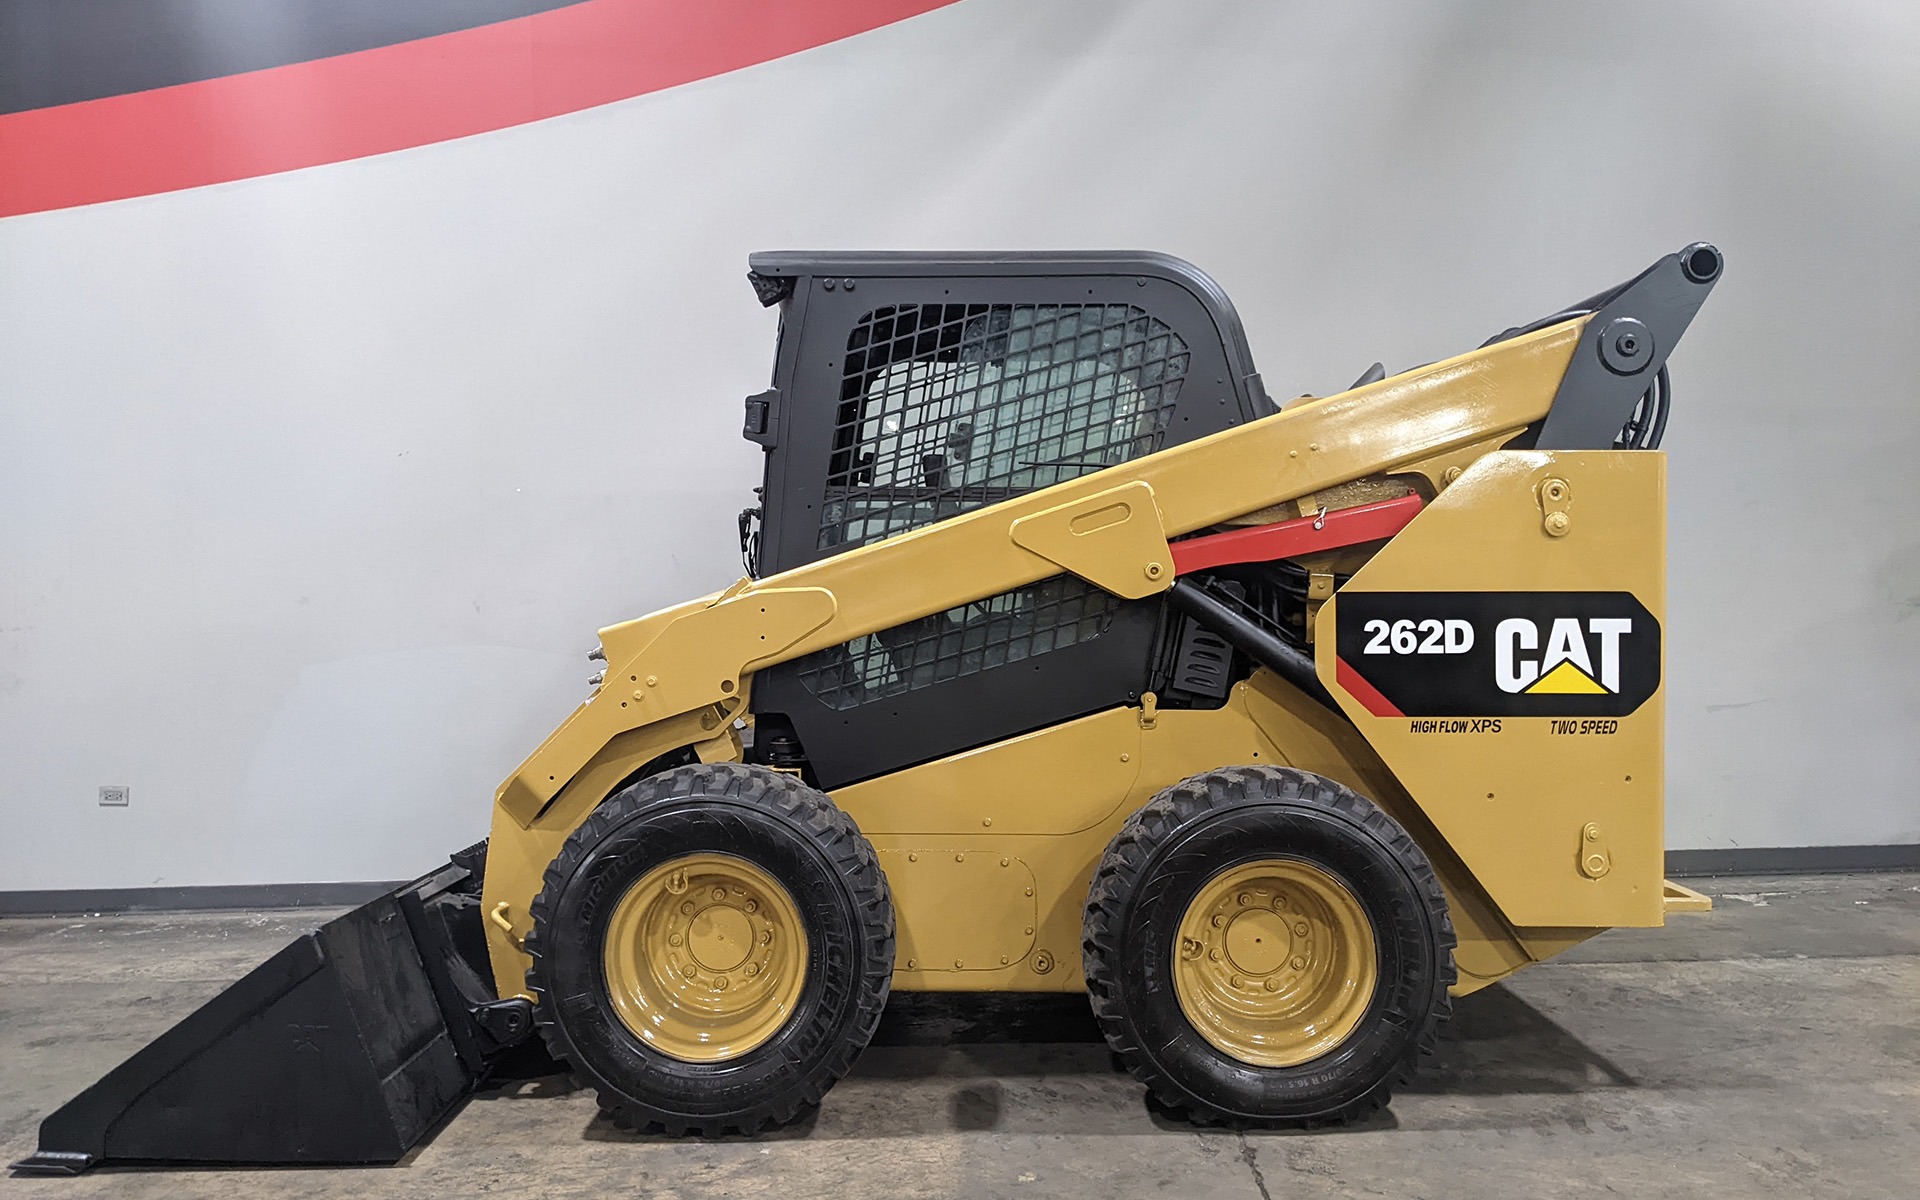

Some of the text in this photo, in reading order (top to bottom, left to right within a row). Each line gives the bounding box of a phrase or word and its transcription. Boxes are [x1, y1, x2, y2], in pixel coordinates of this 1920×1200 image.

[1363, 619, 1475, 655] 262D
[1495, 618, 1632, 694] CAT
[1410, 719, 1502, 733] HIGH FLOW XPS
[1551, 720, 1618, 734] TWO SPEED
[796, 903, 847, 1060] MICHELIN
